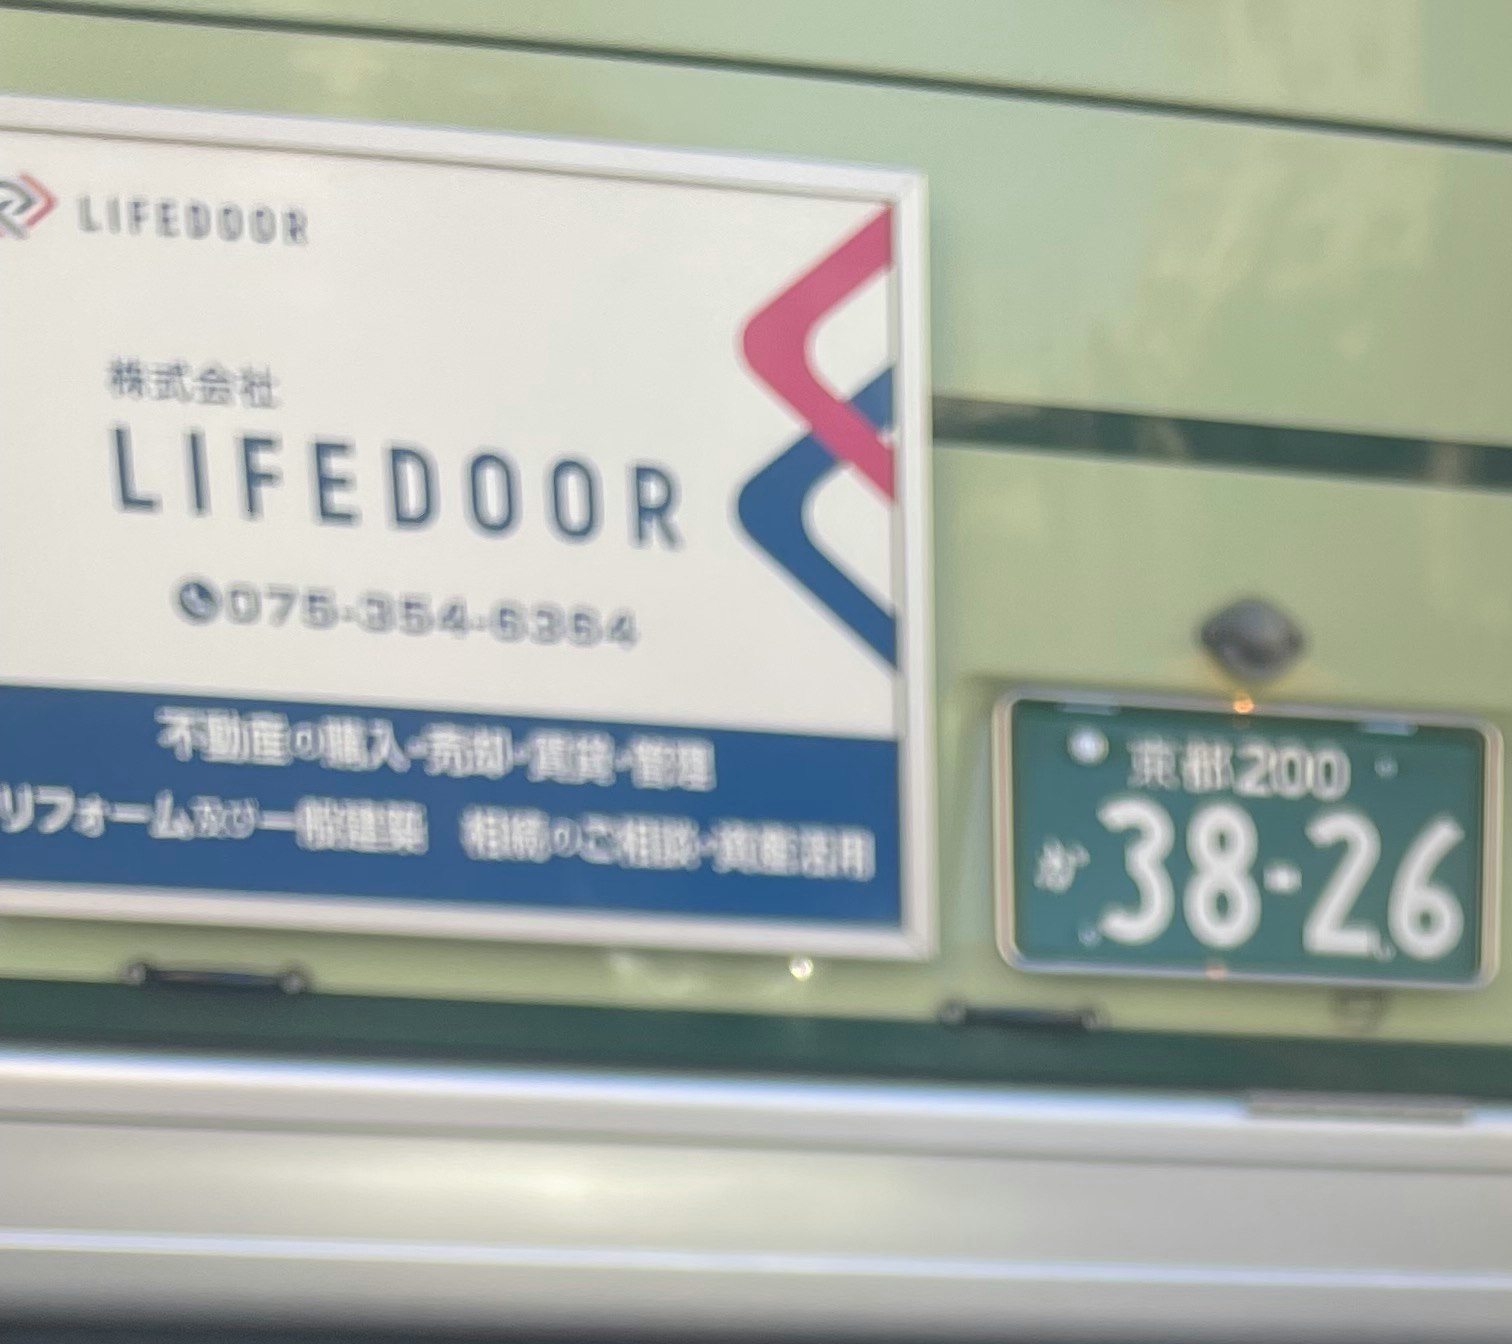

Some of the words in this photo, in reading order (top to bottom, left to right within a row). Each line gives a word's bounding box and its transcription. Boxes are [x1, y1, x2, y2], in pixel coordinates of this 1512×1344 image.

[77, 195, 309, 244] LIFEDOOR
[108, 357, 282, 409] 株式会社
[109, 423, 686, 553] LIFEDOOR
[1096, 795, 1466, 961] 38-26
